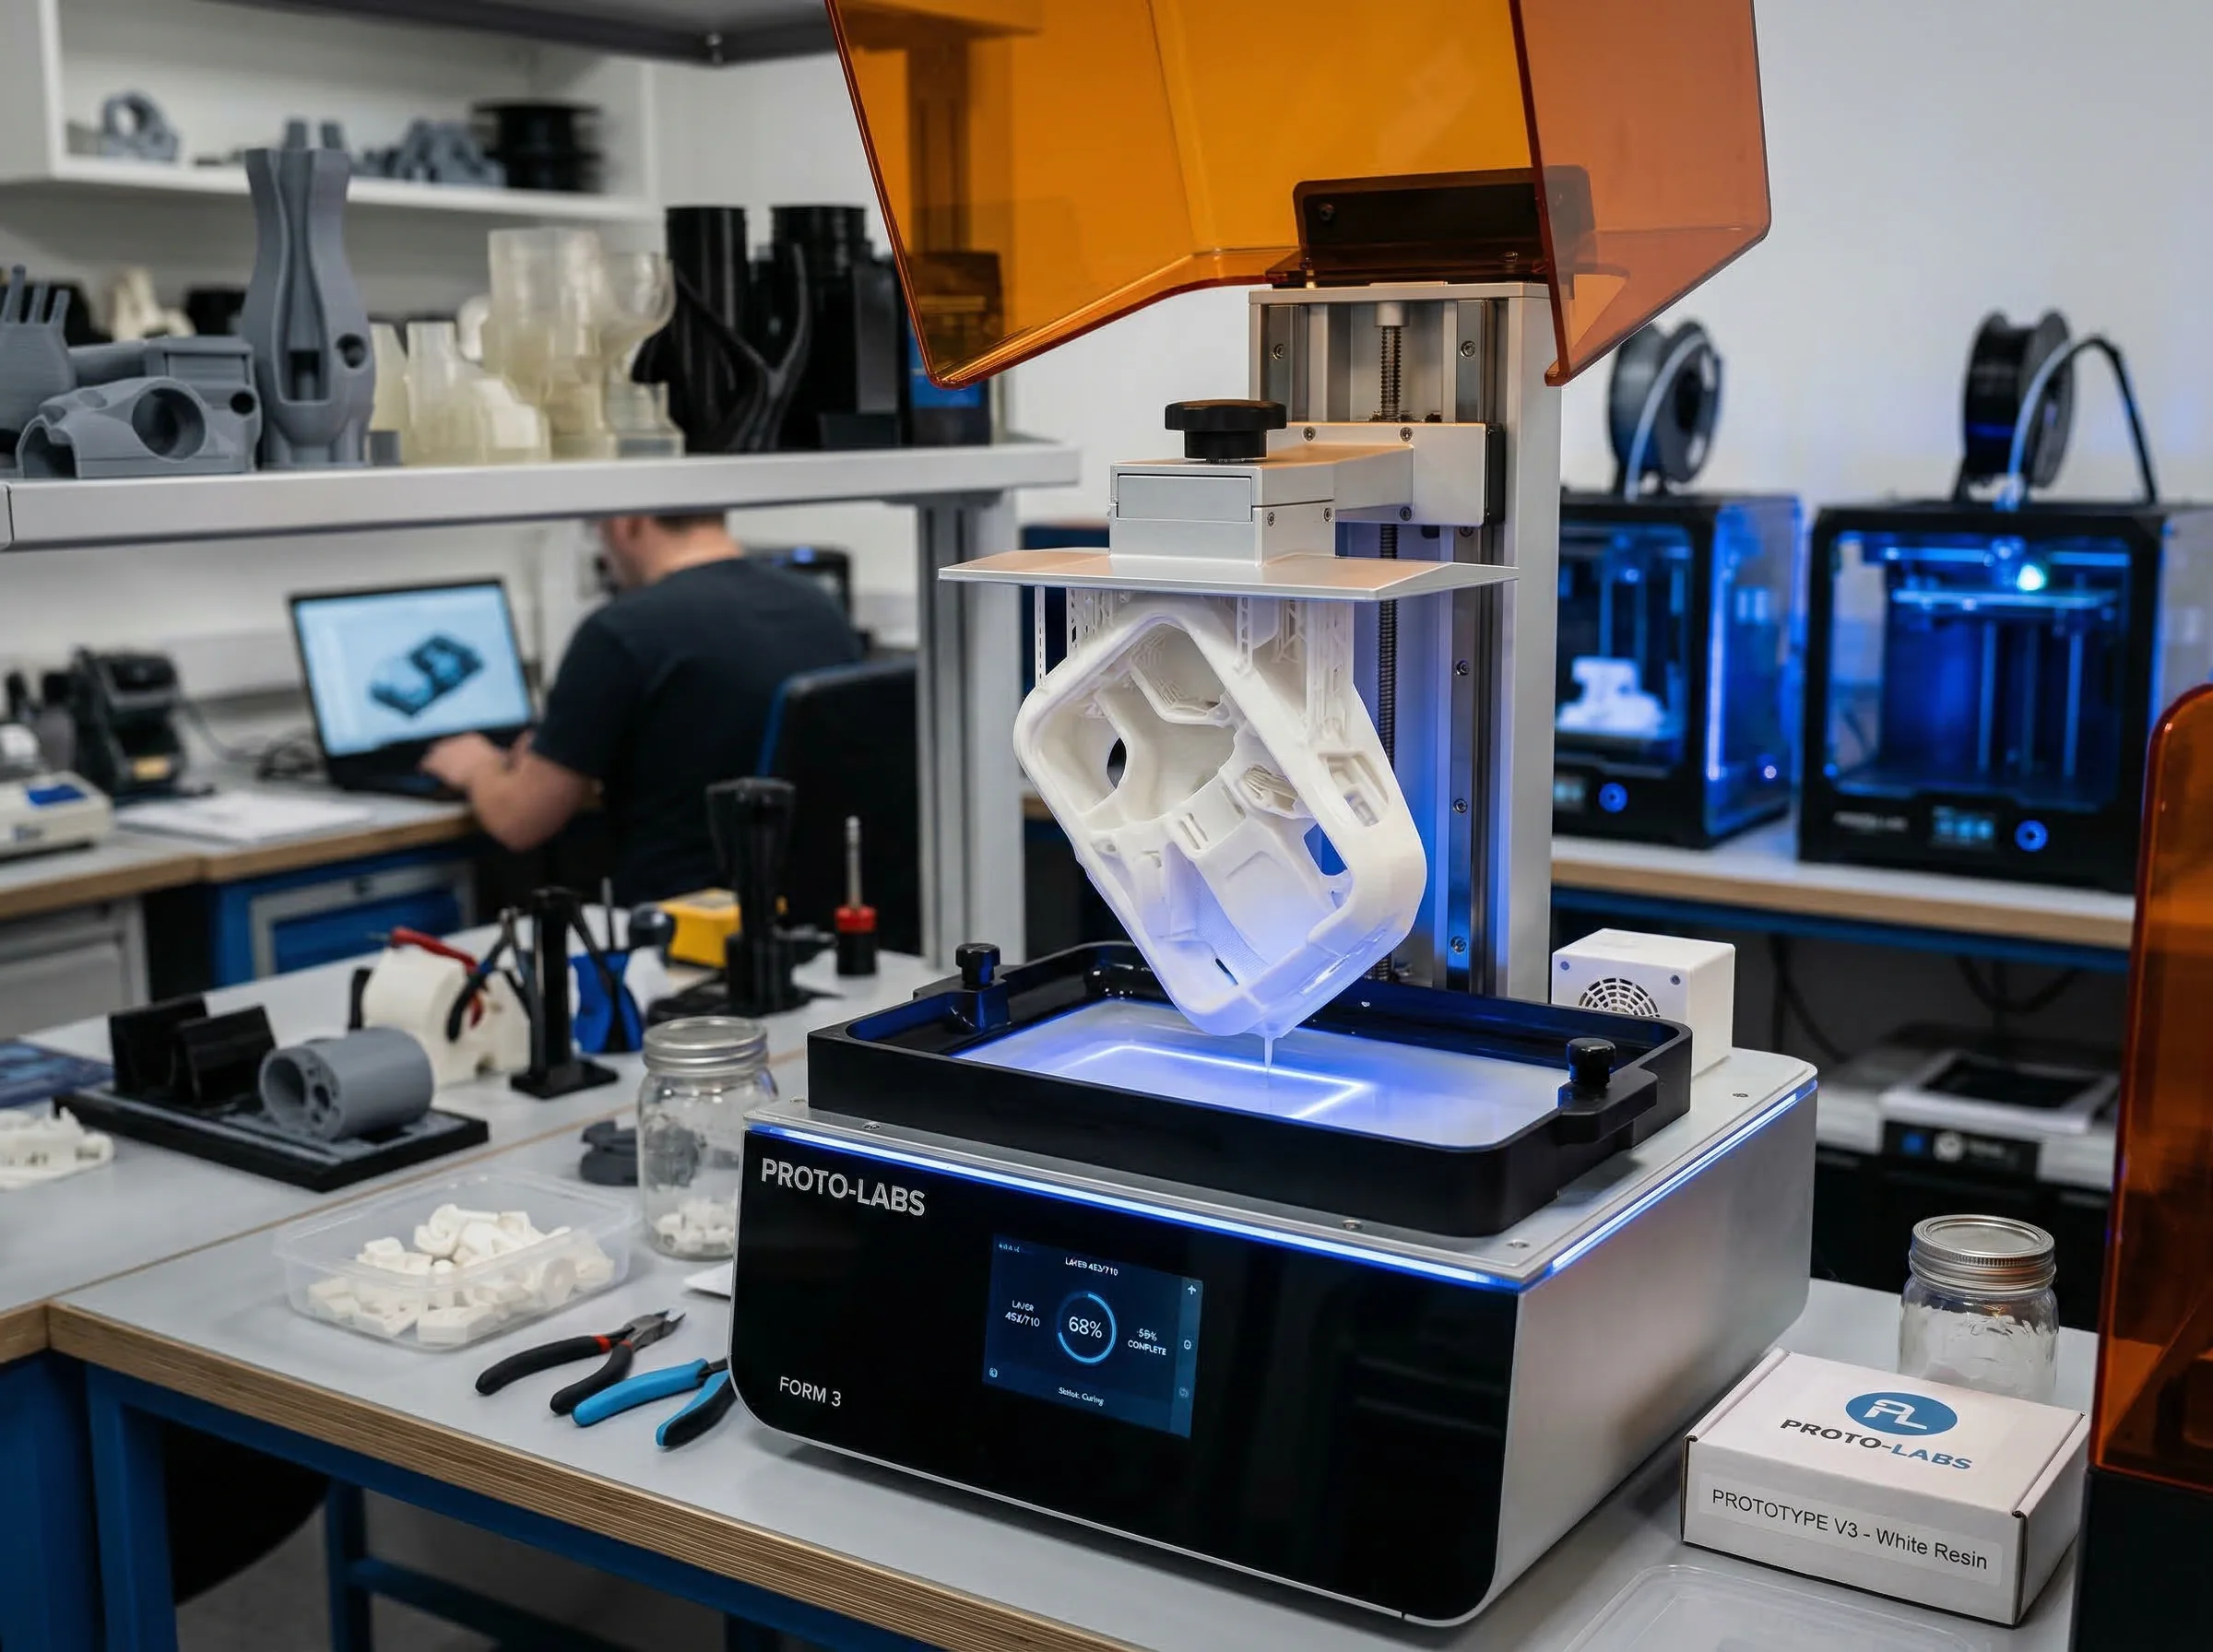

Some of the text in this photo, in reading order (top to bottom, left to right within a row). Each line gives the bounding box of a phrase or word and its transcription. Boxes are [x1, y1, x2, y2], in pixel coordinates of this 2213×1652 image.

[761, 1158, 926, 1217] PROTO-LABS
[1068, 1316, 1103, 1339] 68%
[779, 1376, 842, 1407] FORM 3
[1780, 1419, 1972, 1469] PROTO-LABS
[1712, 1488, 1828, 1531] PROTOTYPE
[1834, 1517, 1858, 1539] V3
[1876, 1528, 1928, 1555] White
[1935, 1541, 1987, 1570] Resin
